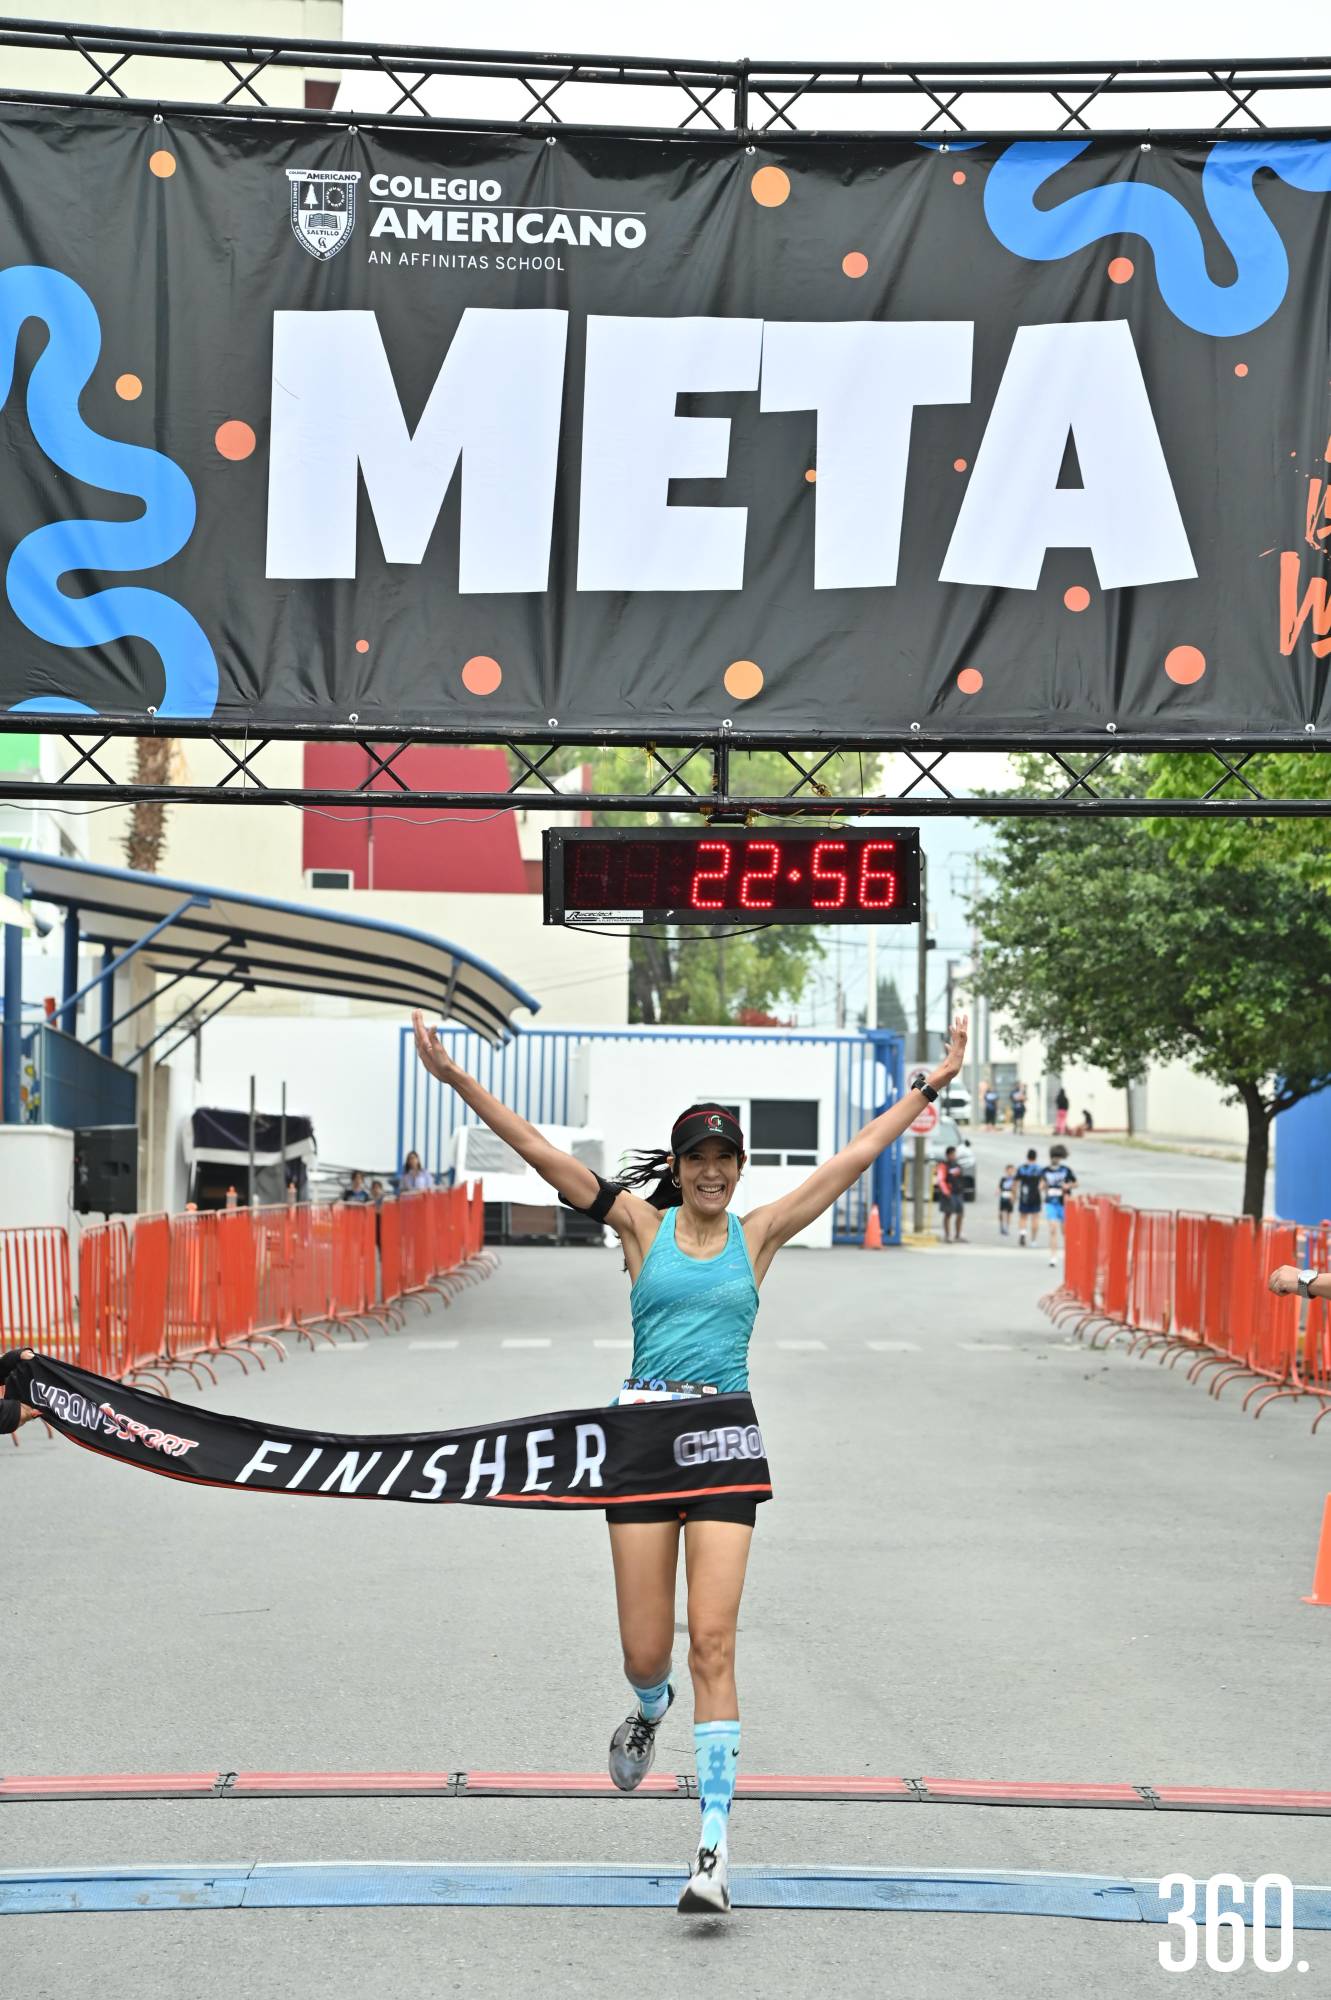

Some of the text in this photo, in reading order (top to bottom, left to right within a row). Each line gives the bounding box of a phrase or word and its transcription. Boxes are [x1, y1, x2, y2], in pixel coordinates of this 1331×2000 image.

[306, 173, 357, 181] AMERICANO
[368, 173, 503, 202] COLEGIO
[306, 229, 340, 237] SALTILLO
[369, 207, 647, 249] AMERICANO
[368, 250, 566, 272] AN AFFINITAS SCHOOL
[265, 307, 1199, 594] META
[233, 1422, 608, 1501] FINISHER
[673, 1424, 767, 1467] CHRO
